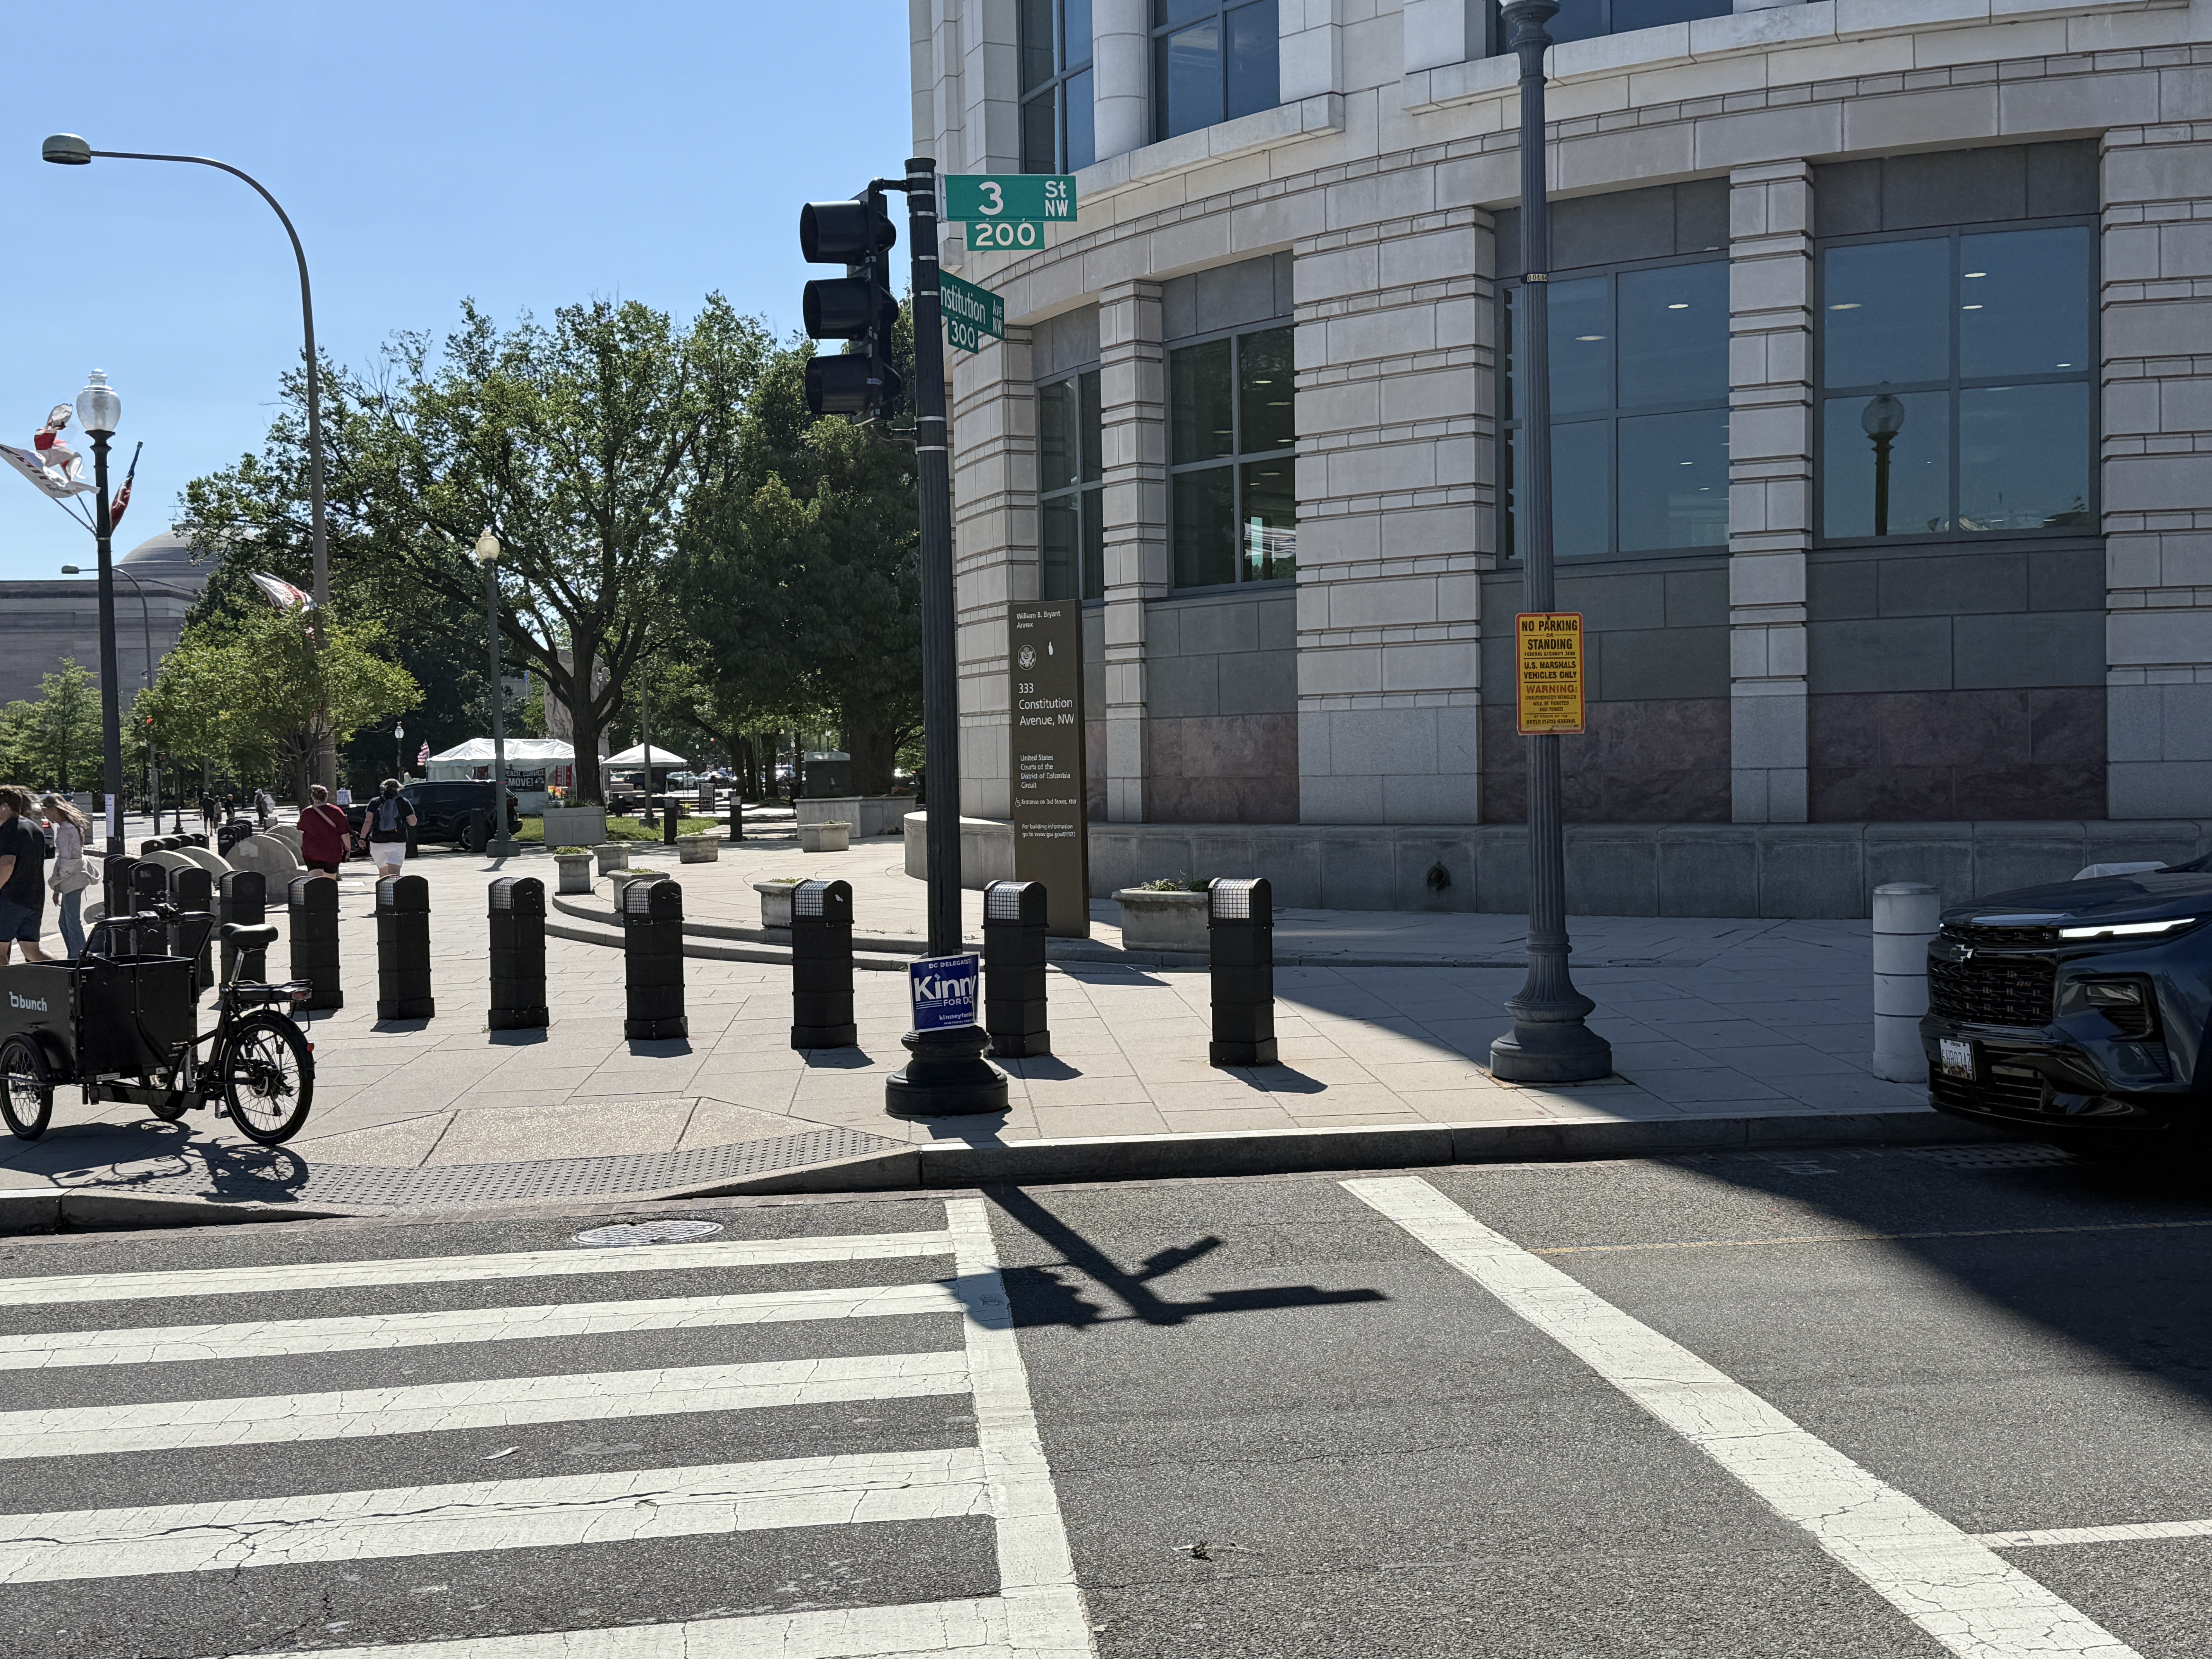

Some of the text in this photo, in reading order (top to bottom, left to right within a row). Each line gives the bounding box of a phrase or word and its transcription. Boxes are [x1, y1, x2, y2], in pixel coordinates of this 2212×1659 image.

[978, 181, 1066, 215] 3 St
[1045, 200, 1068, 216] NW
[975, 223, 1035, 246] 200
[941, 285, 1002, 325] nstitution Ave
[951, 320, 975, 349] 300
[1044, 610, 1061, 619] Bryant
[1522, 620, 1578, 632] NO PARKING
[1528, 639, 1573, 650] STANDING
[1018, 683, 1034, 694] 333
[1019, 697, 1072, 709] Constitution
[1020, 713, 1074, 726] Avenue, NW
[505, 777, 533, 787] MOVE!
[19, 994, 47, 1012] bunch
[943, 995, 973, 1006] FOR DC
